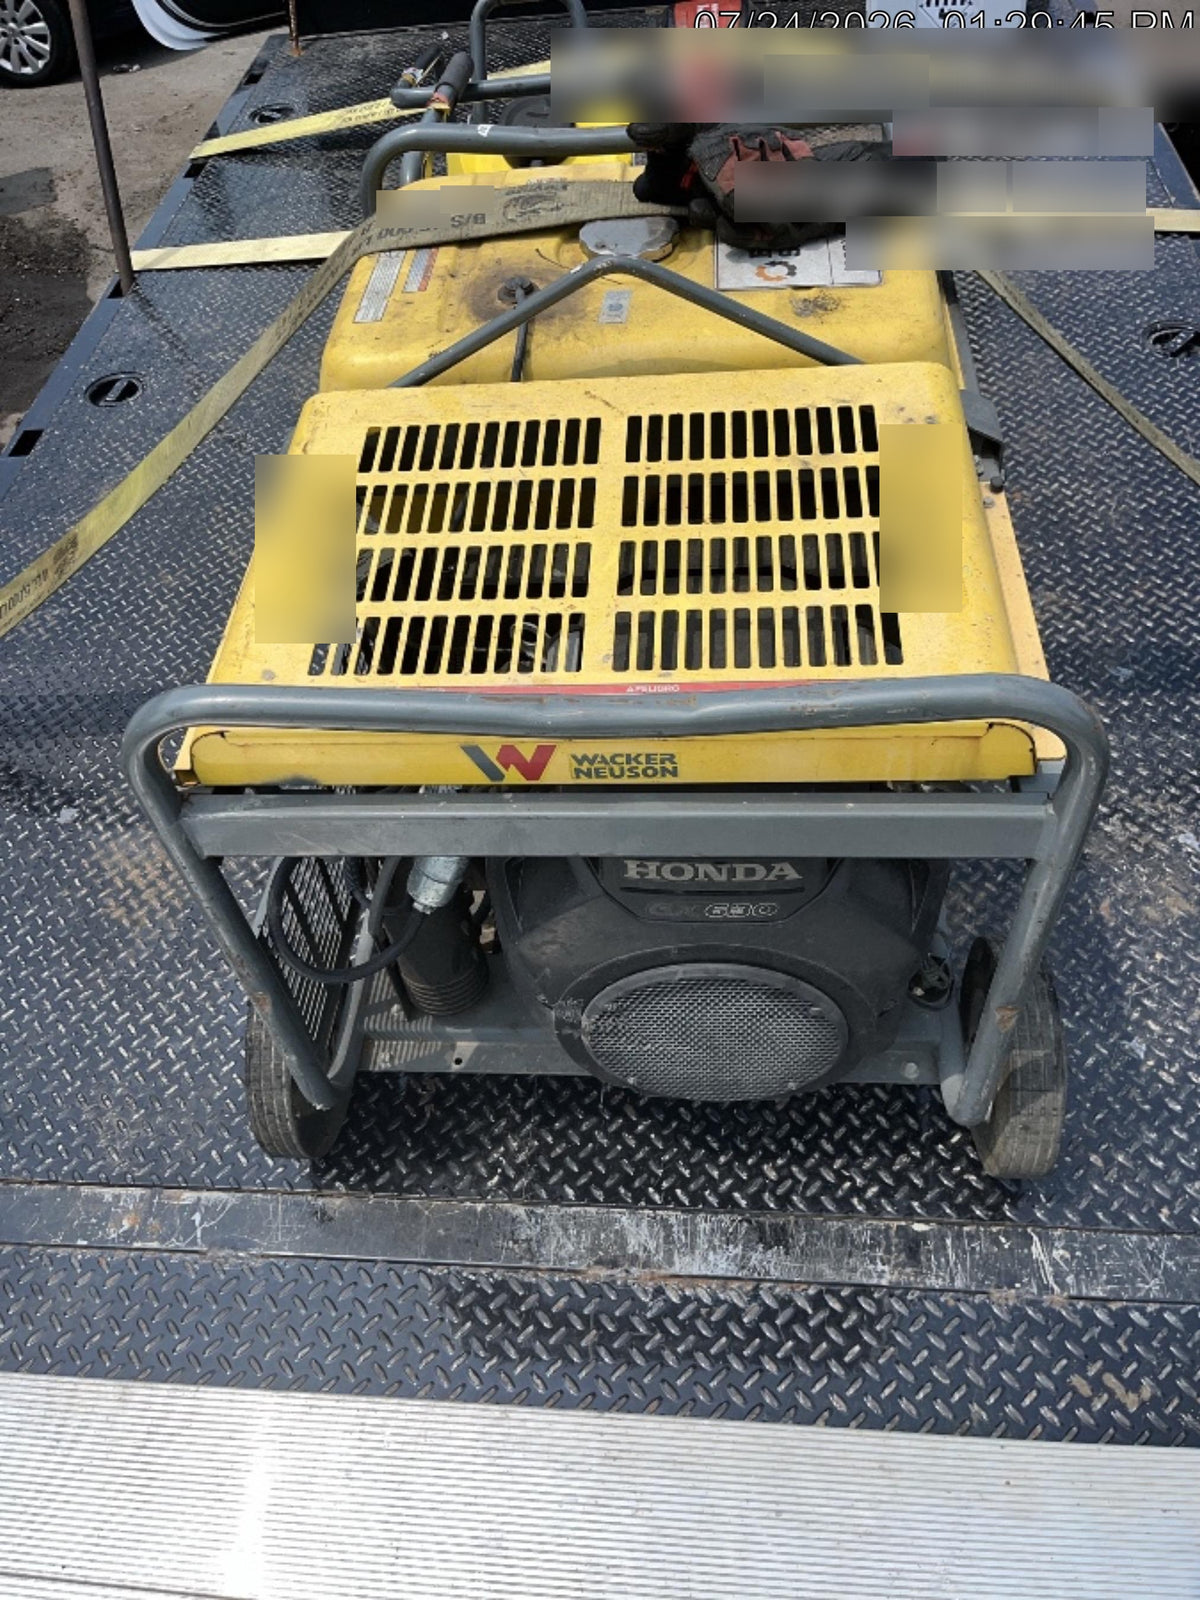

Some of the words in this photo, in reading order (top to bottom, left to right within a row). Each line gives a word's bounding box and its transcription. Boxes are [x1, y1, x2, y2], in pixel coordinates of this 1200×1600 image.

[450, 213, 487, 228] B/S
[571, 753, 678, 766] WACKER
[573, 766, 678, 779] NEUSON
[623, 860, 802, 881] HONDA
